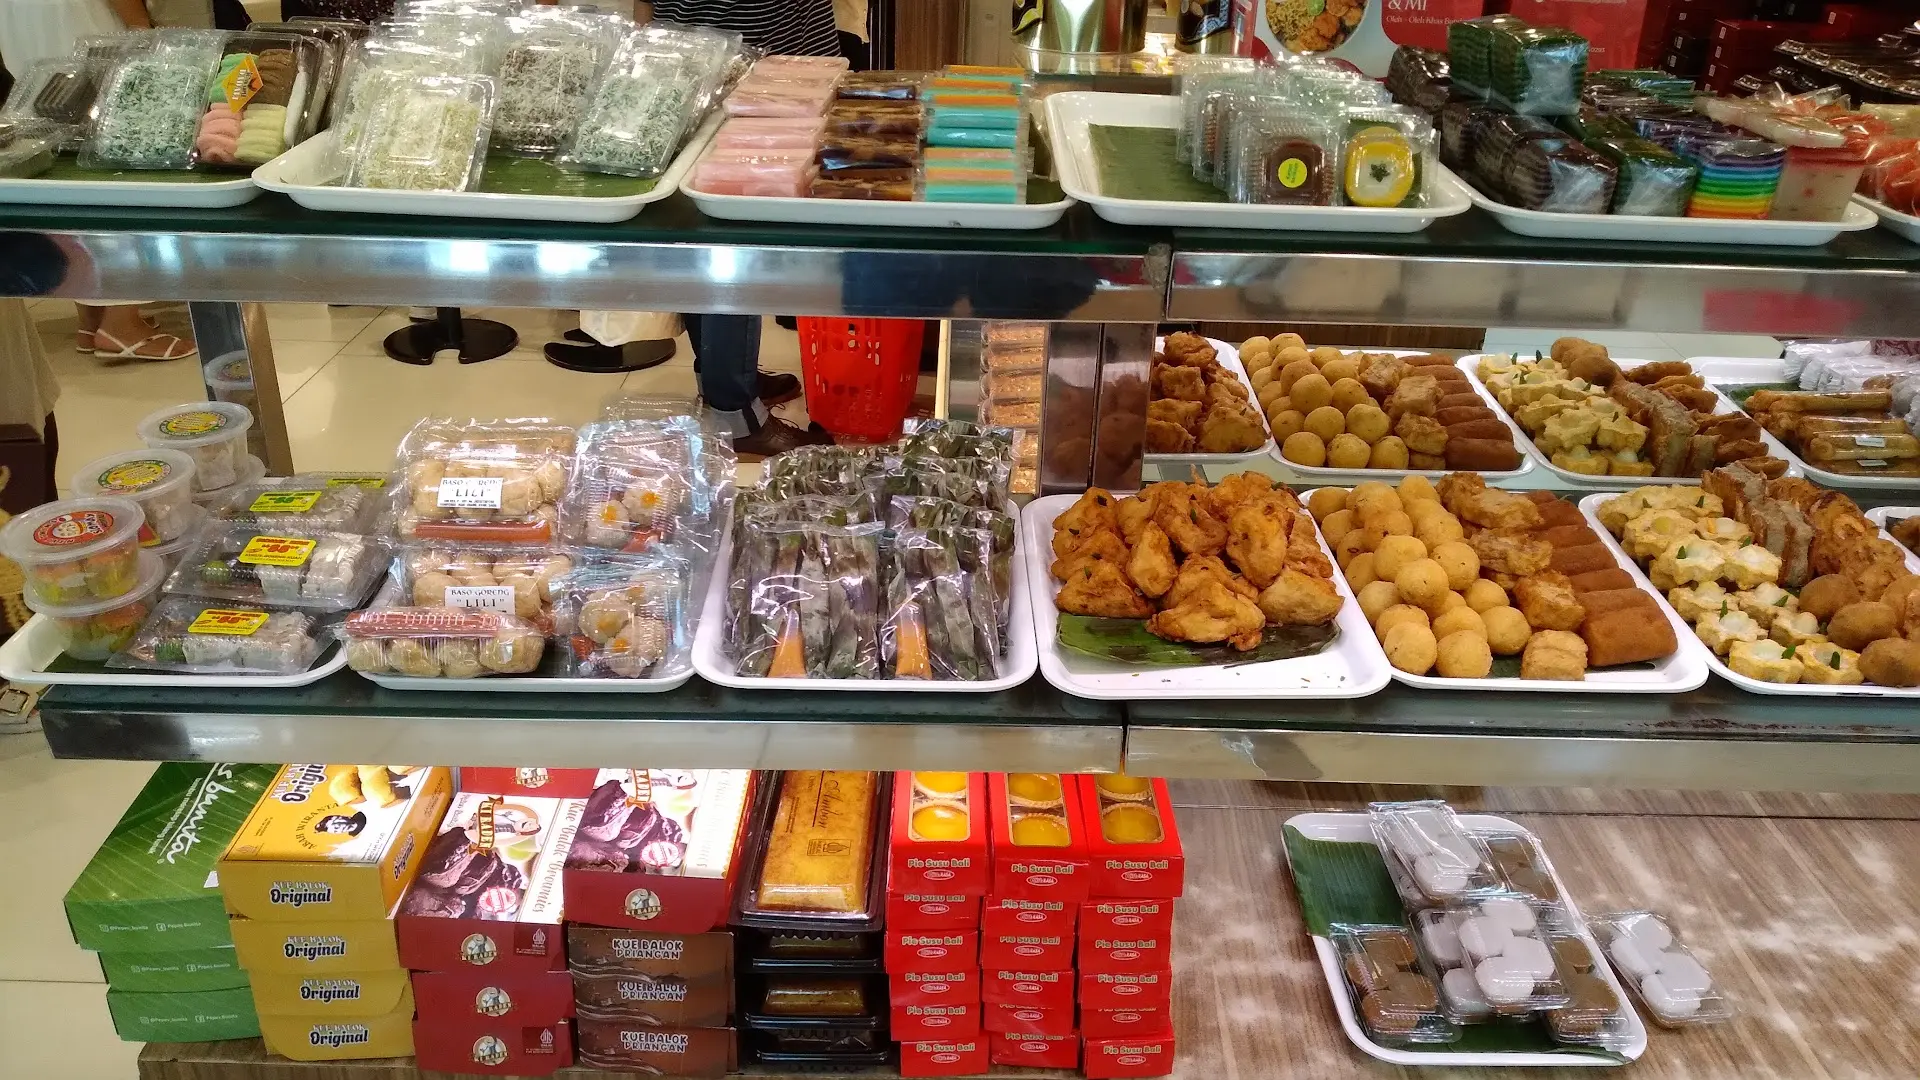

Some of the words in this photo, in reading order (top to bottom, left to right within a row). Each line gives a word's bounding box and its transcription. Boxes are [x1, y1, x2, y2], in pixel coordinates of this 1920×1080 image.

[480, 801, 492, 814] KI
[479, 816, 494, 848] RADEN
[907, 858, 924, 868] Pie
[925, 858, 949, 868] Susu
[951, 858, 970, 867] Bali
[1011, 863, 1028, 873] Pie
[1029, 864, 1053, 873] Susu
[1054, 865, 1074, 874] Bali
[1105, 860, 1122, 869] Pie
[1123, 860, 1148, 869] Susu
[1149, 860, 1168, 869] Bali
[532, 860, 564, 913] Brownies
[269, 887, 332, 908] Original
[1001, 899, 1018, 909] Pie
[1019, 900, 1043, 910] Susu
[1044, 901, 1063, 911] Bali
[1097, 904, 1113, 913] Pie
[1114, 904, 1139, 913] Susu
[1139, 904, 1159, 914] Bali
[612, 938, 639, 950] KUE
[640, 939, 683, 952] BALOK
[902, 936, 918, 945] Pie
[919, 937, 942, 945] Susu
[944, 936, 963, 945] Bali
[1017, 936, 1040, 944] Susu
[1042, 937, 1060, 945] Bali
[1095, 940, 1111, 948] Pie
[1112, 940, 1136, 949] Susu
[1137, 940, 1156, 948] Bali
[283, 941, 346, 961] Original
[616, 949, 680, 960] PRIANGAN
[905, 973, 921, 981] Pie
[922, 973, 945, 981] Susu
[946, 973, 965, 981] Bali
[998, 971, 1014, 980] Pie
[1015, 972, 1038, 981] Susu
[1040, 973, 1058, 982] Bali
[1098, 974, 1113, 983] Pie
[1114, 975, 1138, 983] Susu
[1139, 975, 1158, 983] Bali
[617, 982, 643, 992] KUE
[300, 984, 360, 1004] Original
[621, 991, 684, 1001] PRIANGAN
[906, 1006, 922, 1015] Pie
[923, 1006, 946, 1015] Susu
[947, 1006, 966, 1015] Bali
[309, 1029, 369, 1048] Original
[620, 1031, 645, 1042] KUE
[645, 1033, 688, 1045] BALOK
[624, 1041, 685, 1053] PRIANGAN
[916, 1043, 932, 1052] Pie
[933, 1043, 955, 1052] Susu
[957, 1043, 975, 1051] Bali
[1103, 1046, 1118, 1054] Pie
[1120, 1046, 1142, 1054] Susu
[1143, 1045, 1161, 1053] Bali
